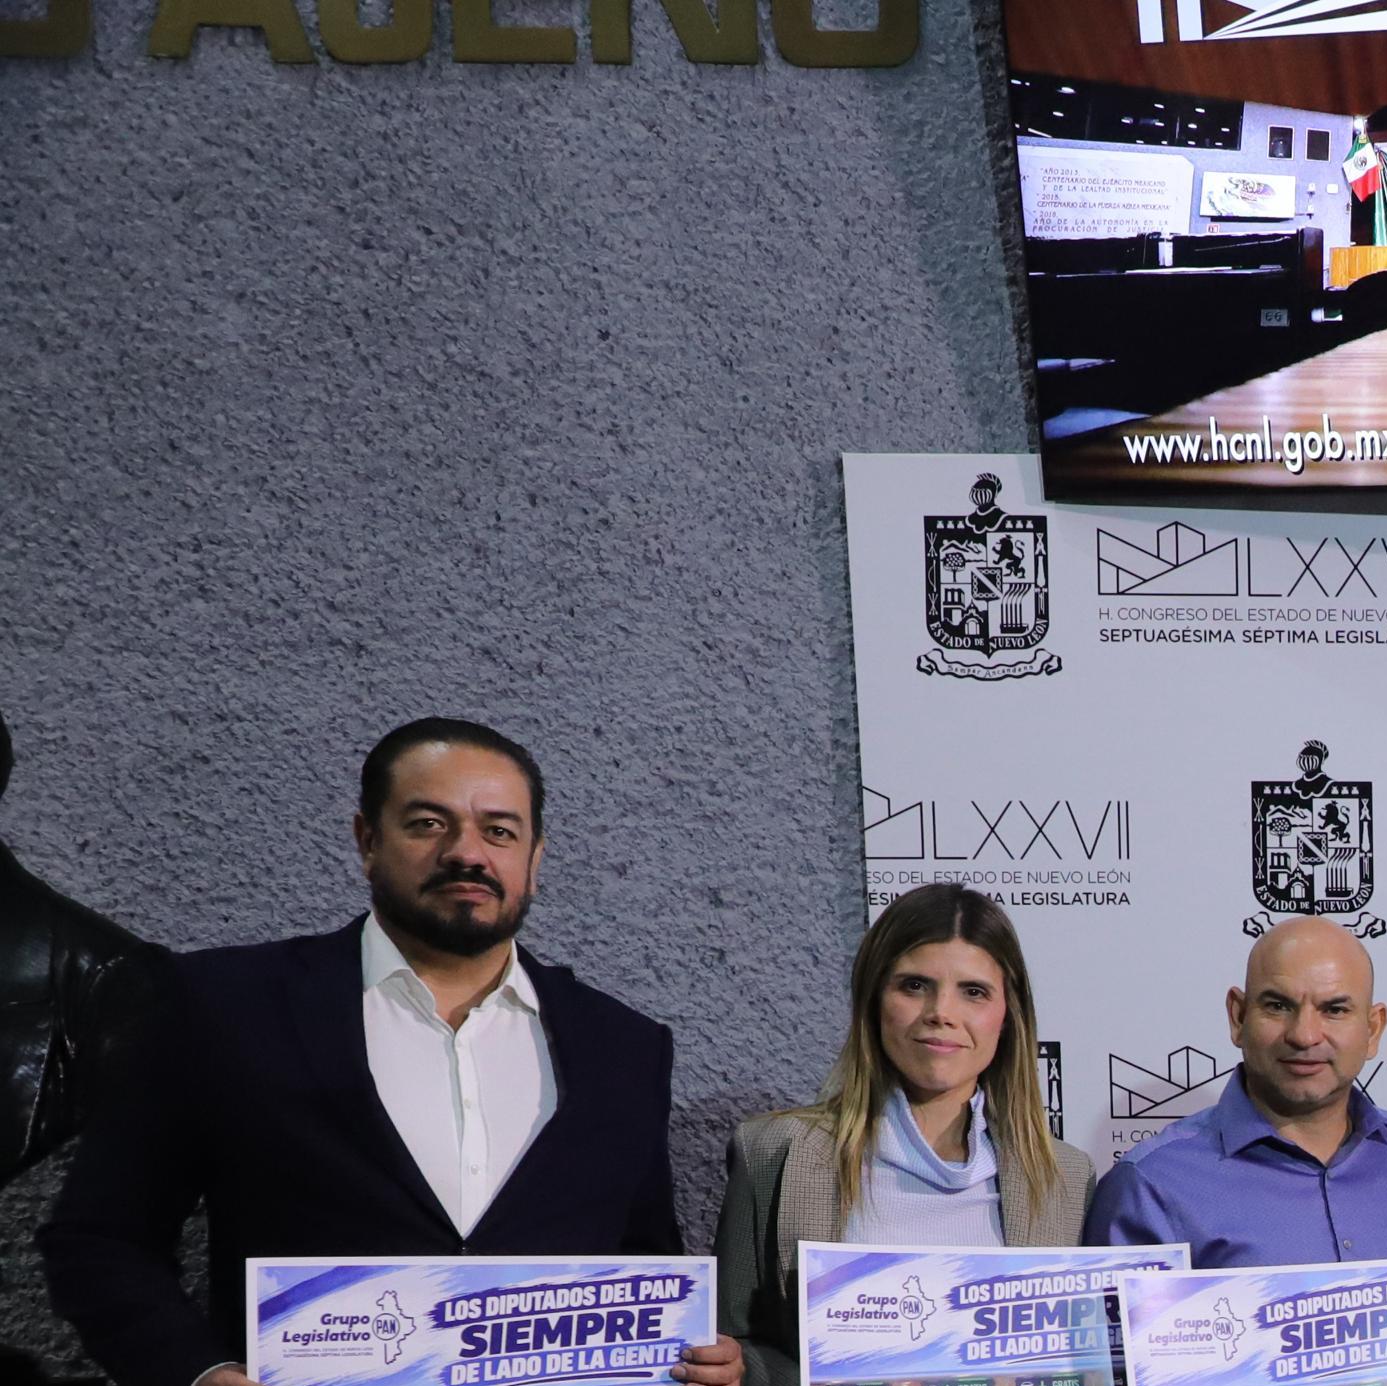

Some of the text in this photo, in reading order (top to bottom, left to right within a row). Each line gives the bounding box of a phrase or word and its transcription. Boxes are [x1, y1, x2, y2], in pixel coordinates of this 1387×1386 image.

[1099, 608, 1112, 620] H.
[1118, 608, 1208, 621] CONGRESO
[1213, 608, 1243, 621] DEL
[1248, 608, 1311, 621] ESTADO
[1316, 609, 1337, 622] DE
[1100, 626, 1235, 643] SEPTUAGÉSIMA
[1243, 627, 1319, 643] SÉPTIMA
[932, 800, 1130, 860] LXXVII
[899, 868, 1131, 884] DEL ESTADO DE NUEVO LEÓN
[1011, 892, 1131, 906] LEGISLATURA
[444, 1278, 681, 1322] LOS DIPUTADOS DEL PAN
[320, 1312, 371, 1329] Grupo
[375, 1317, 397, 1336] PAN
[282, 1326, 371, 1345] Legislativo
[459, 1307, 664, 1358] SIEMPRE
[451, 1343, 681, 1386] DE LADO DE LA GENTE
